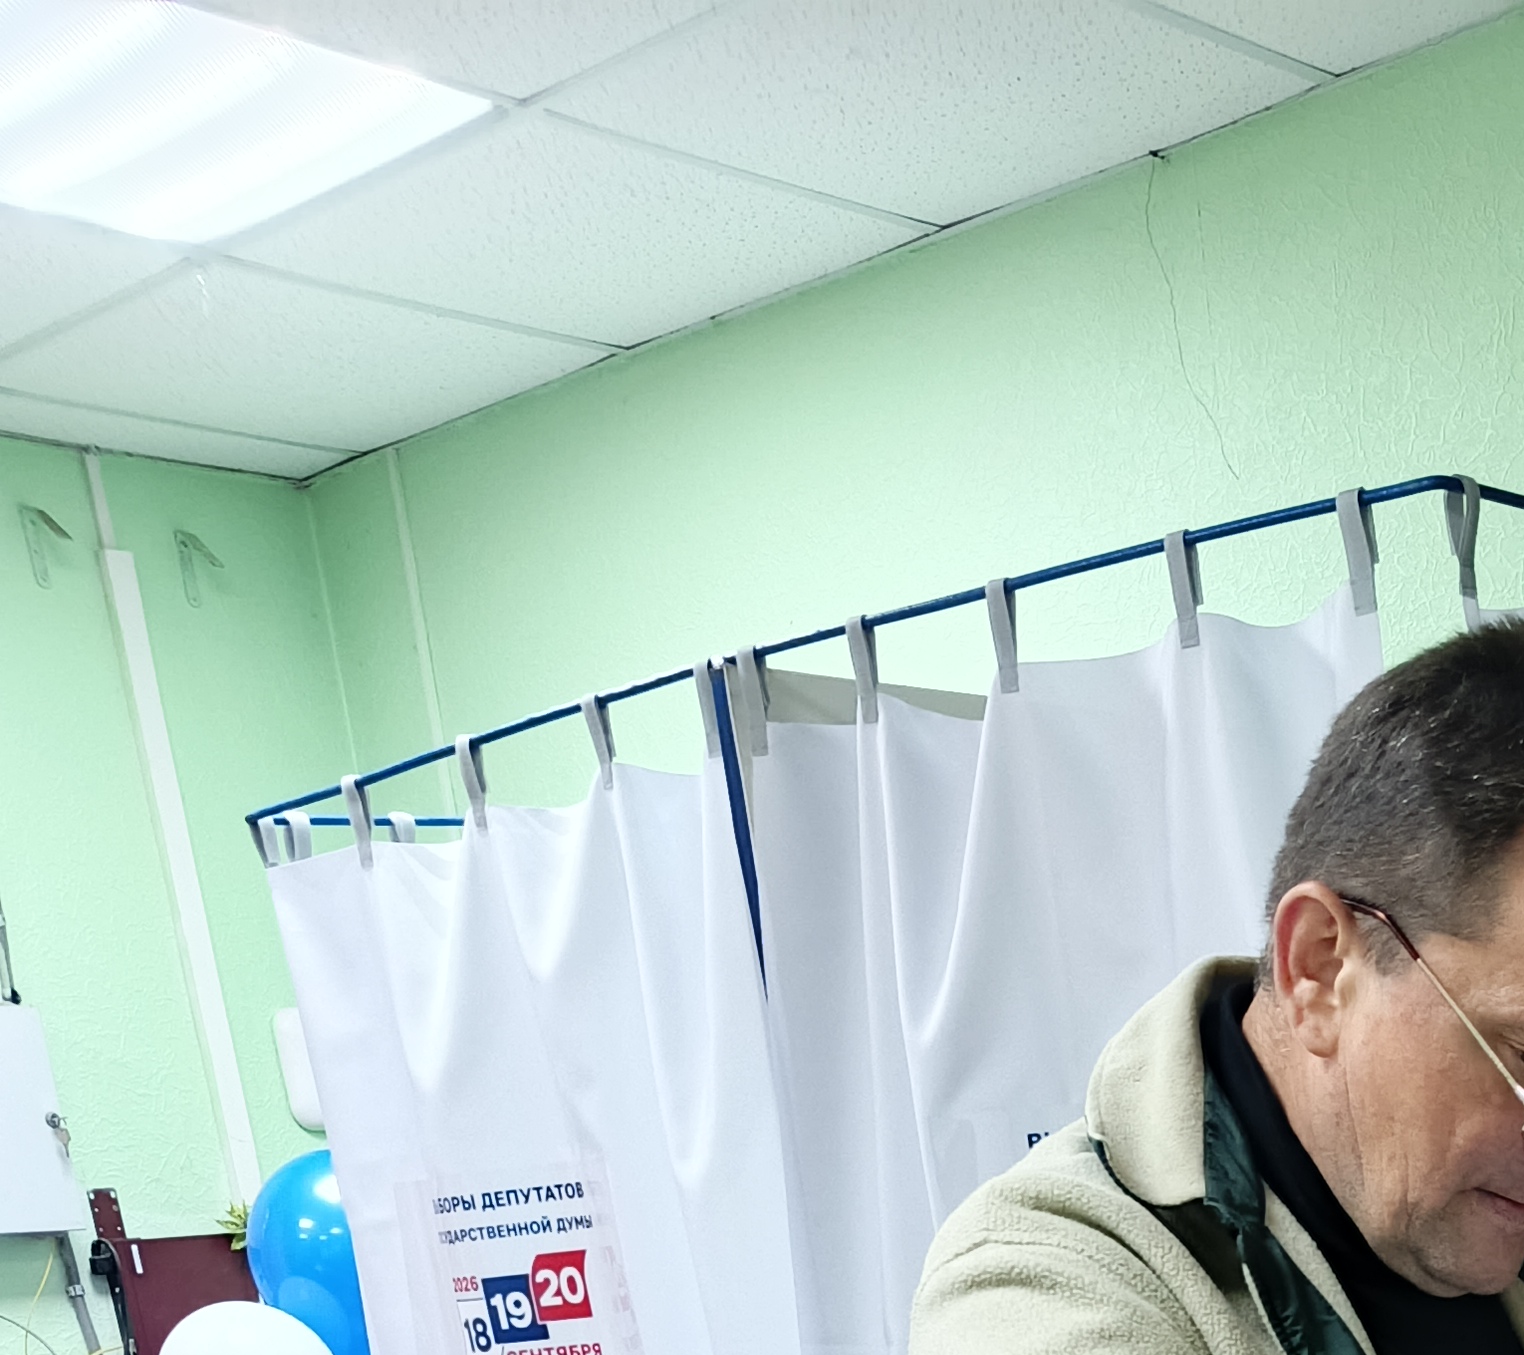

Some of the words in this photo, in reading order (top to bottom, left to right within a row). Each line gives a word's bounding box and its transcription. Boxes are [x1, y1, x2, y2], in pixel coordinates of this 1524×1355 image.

[481, 1181, 585, 1212] ДЕПУТАТОВ
[556, 1214, 594, 1234] ДУМЫ
[453, 1275, 479, 1293] 2026
[463, 1316, 492, 1354] 18
[489, 1290, 534, 1331] 19
[534, 1265, 585, 1308] 20
